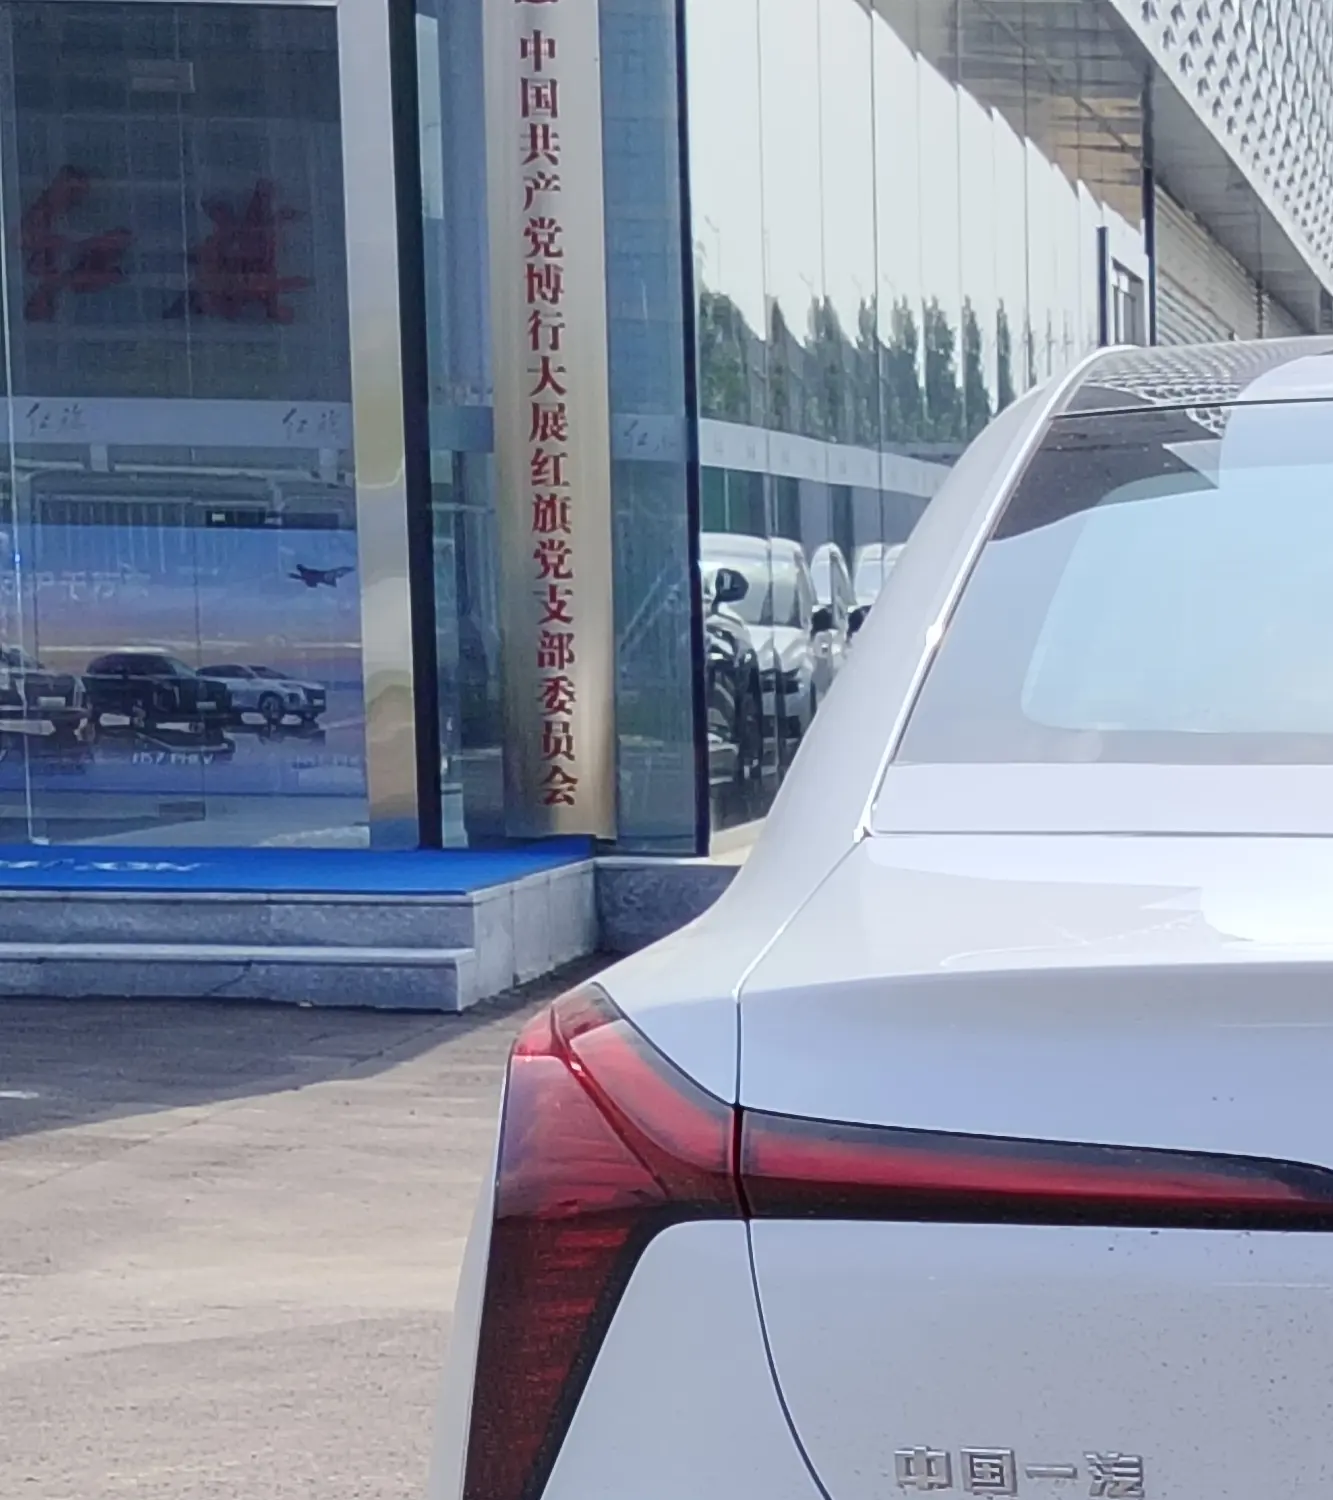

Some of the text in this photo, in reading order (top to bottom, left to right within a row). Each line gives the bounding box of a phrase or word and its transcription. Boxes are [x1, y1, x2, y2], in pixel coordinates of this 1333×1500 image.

[519, 28, 578, 806] 中国共产党博行大展红旗党支部委员会
[894, 1446, 1146, 1500] 中国一汽
